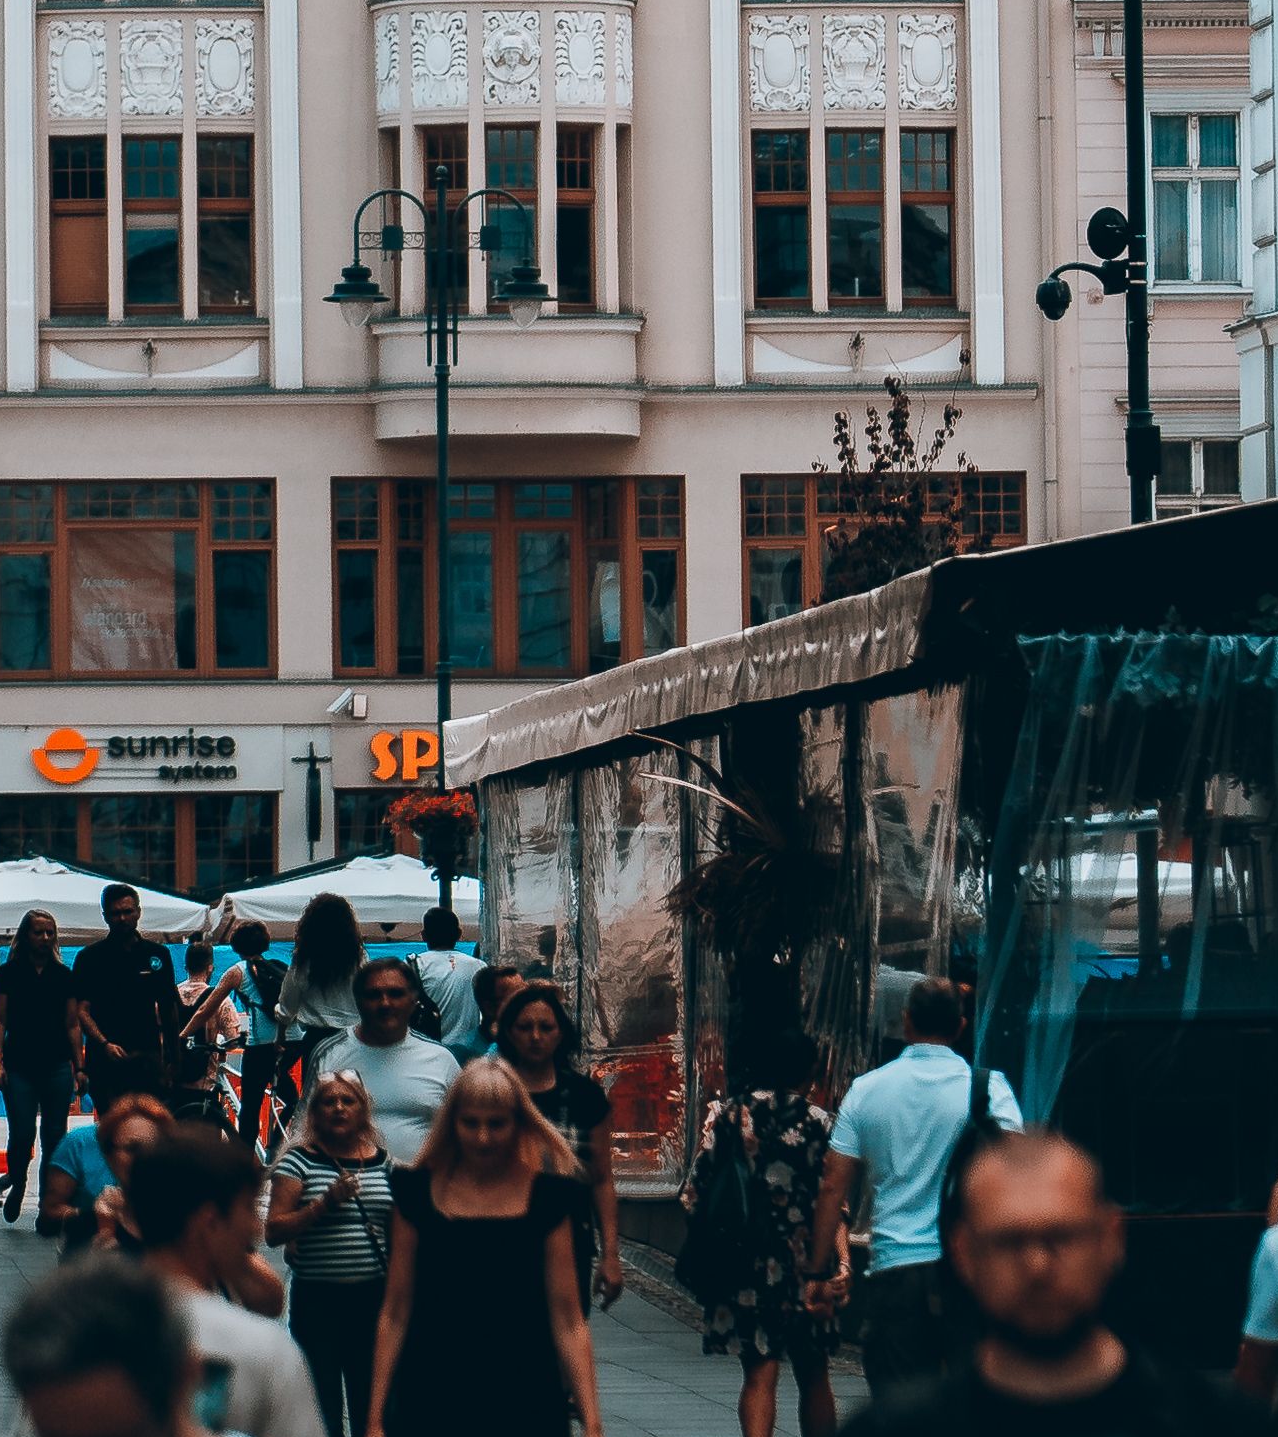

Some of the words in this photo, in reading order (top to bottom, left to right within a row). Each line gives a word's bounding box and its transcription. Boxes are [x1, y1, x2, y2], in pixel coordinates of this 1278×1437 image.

[107, 728, 236, 757] sunrise
[370, 730, 439, 781] SP
[158, 761, 237, 785] system
